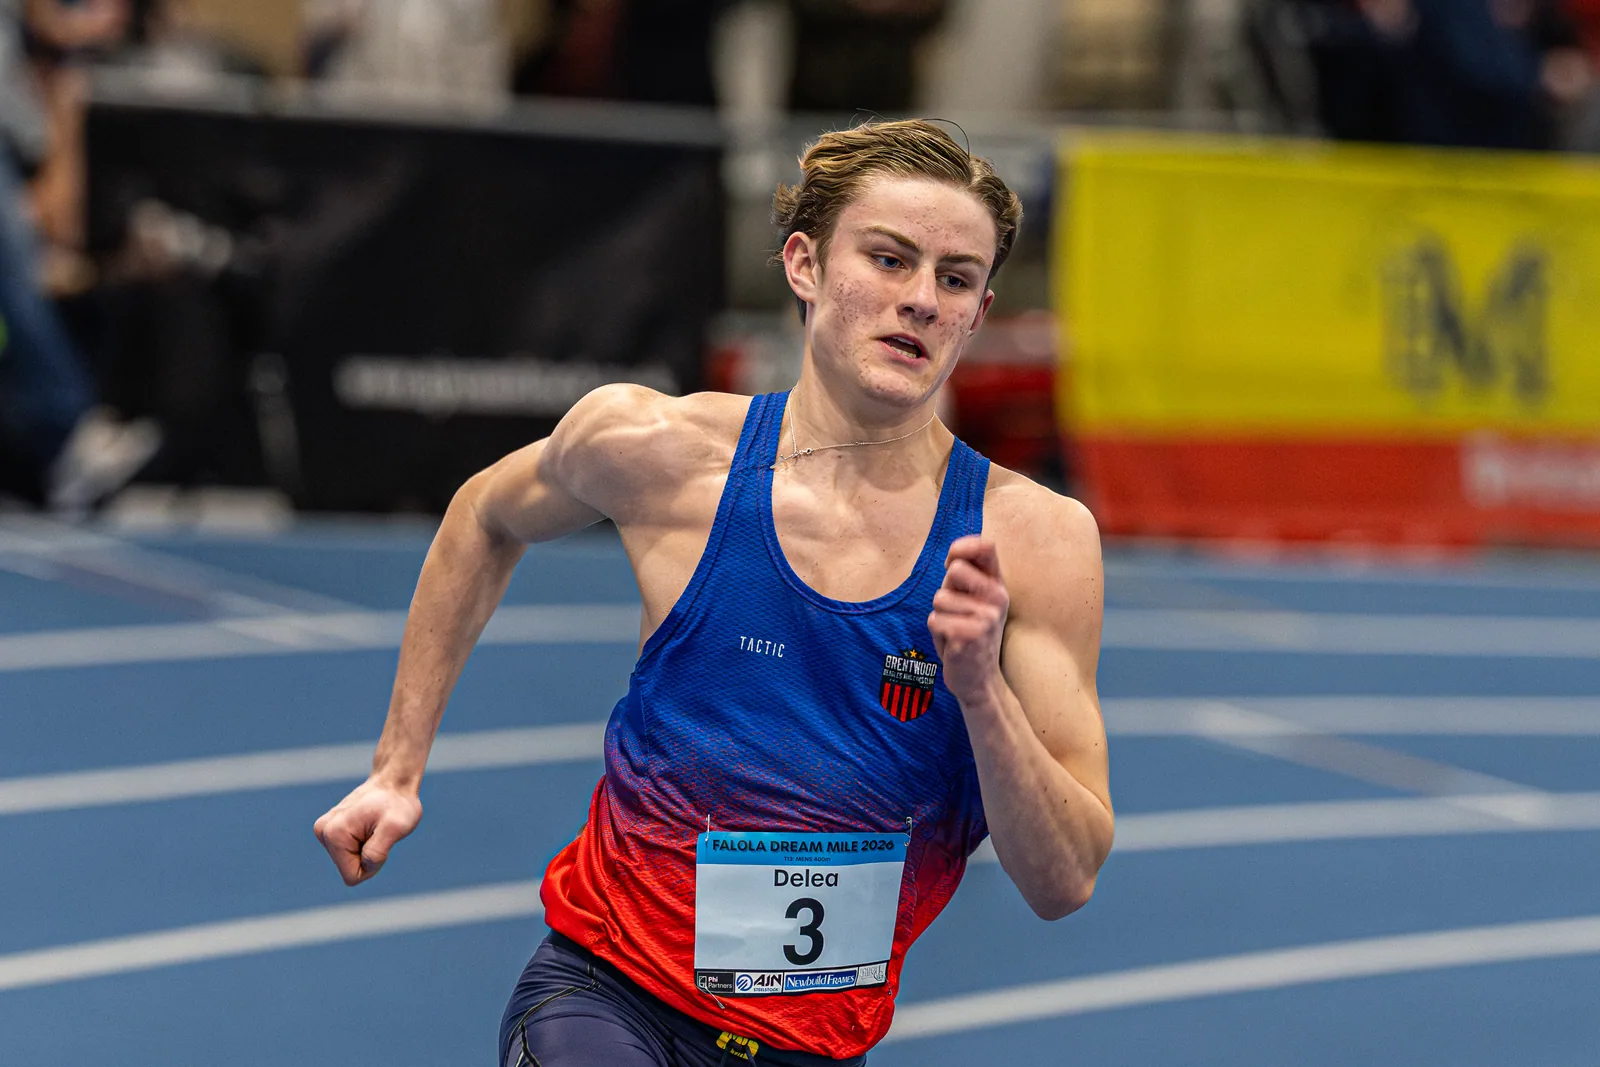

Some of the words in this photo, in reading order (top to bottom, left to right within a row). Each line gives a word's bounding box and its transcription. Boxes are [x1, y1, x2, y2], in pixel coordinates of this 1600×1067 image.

[740, 635, 785, 658] TACTIC
[885, 654, 938, 677] BRENTWOOD
[712, 839, 766, 851] FALOLA
[770, 840, 822, 853] DREAM
[827, 840, 858, 854] MILE
[861, 839, 894, 851] 2026
[774, 869, 839, 887] Delea
[783, 897, 825, 966] 3
